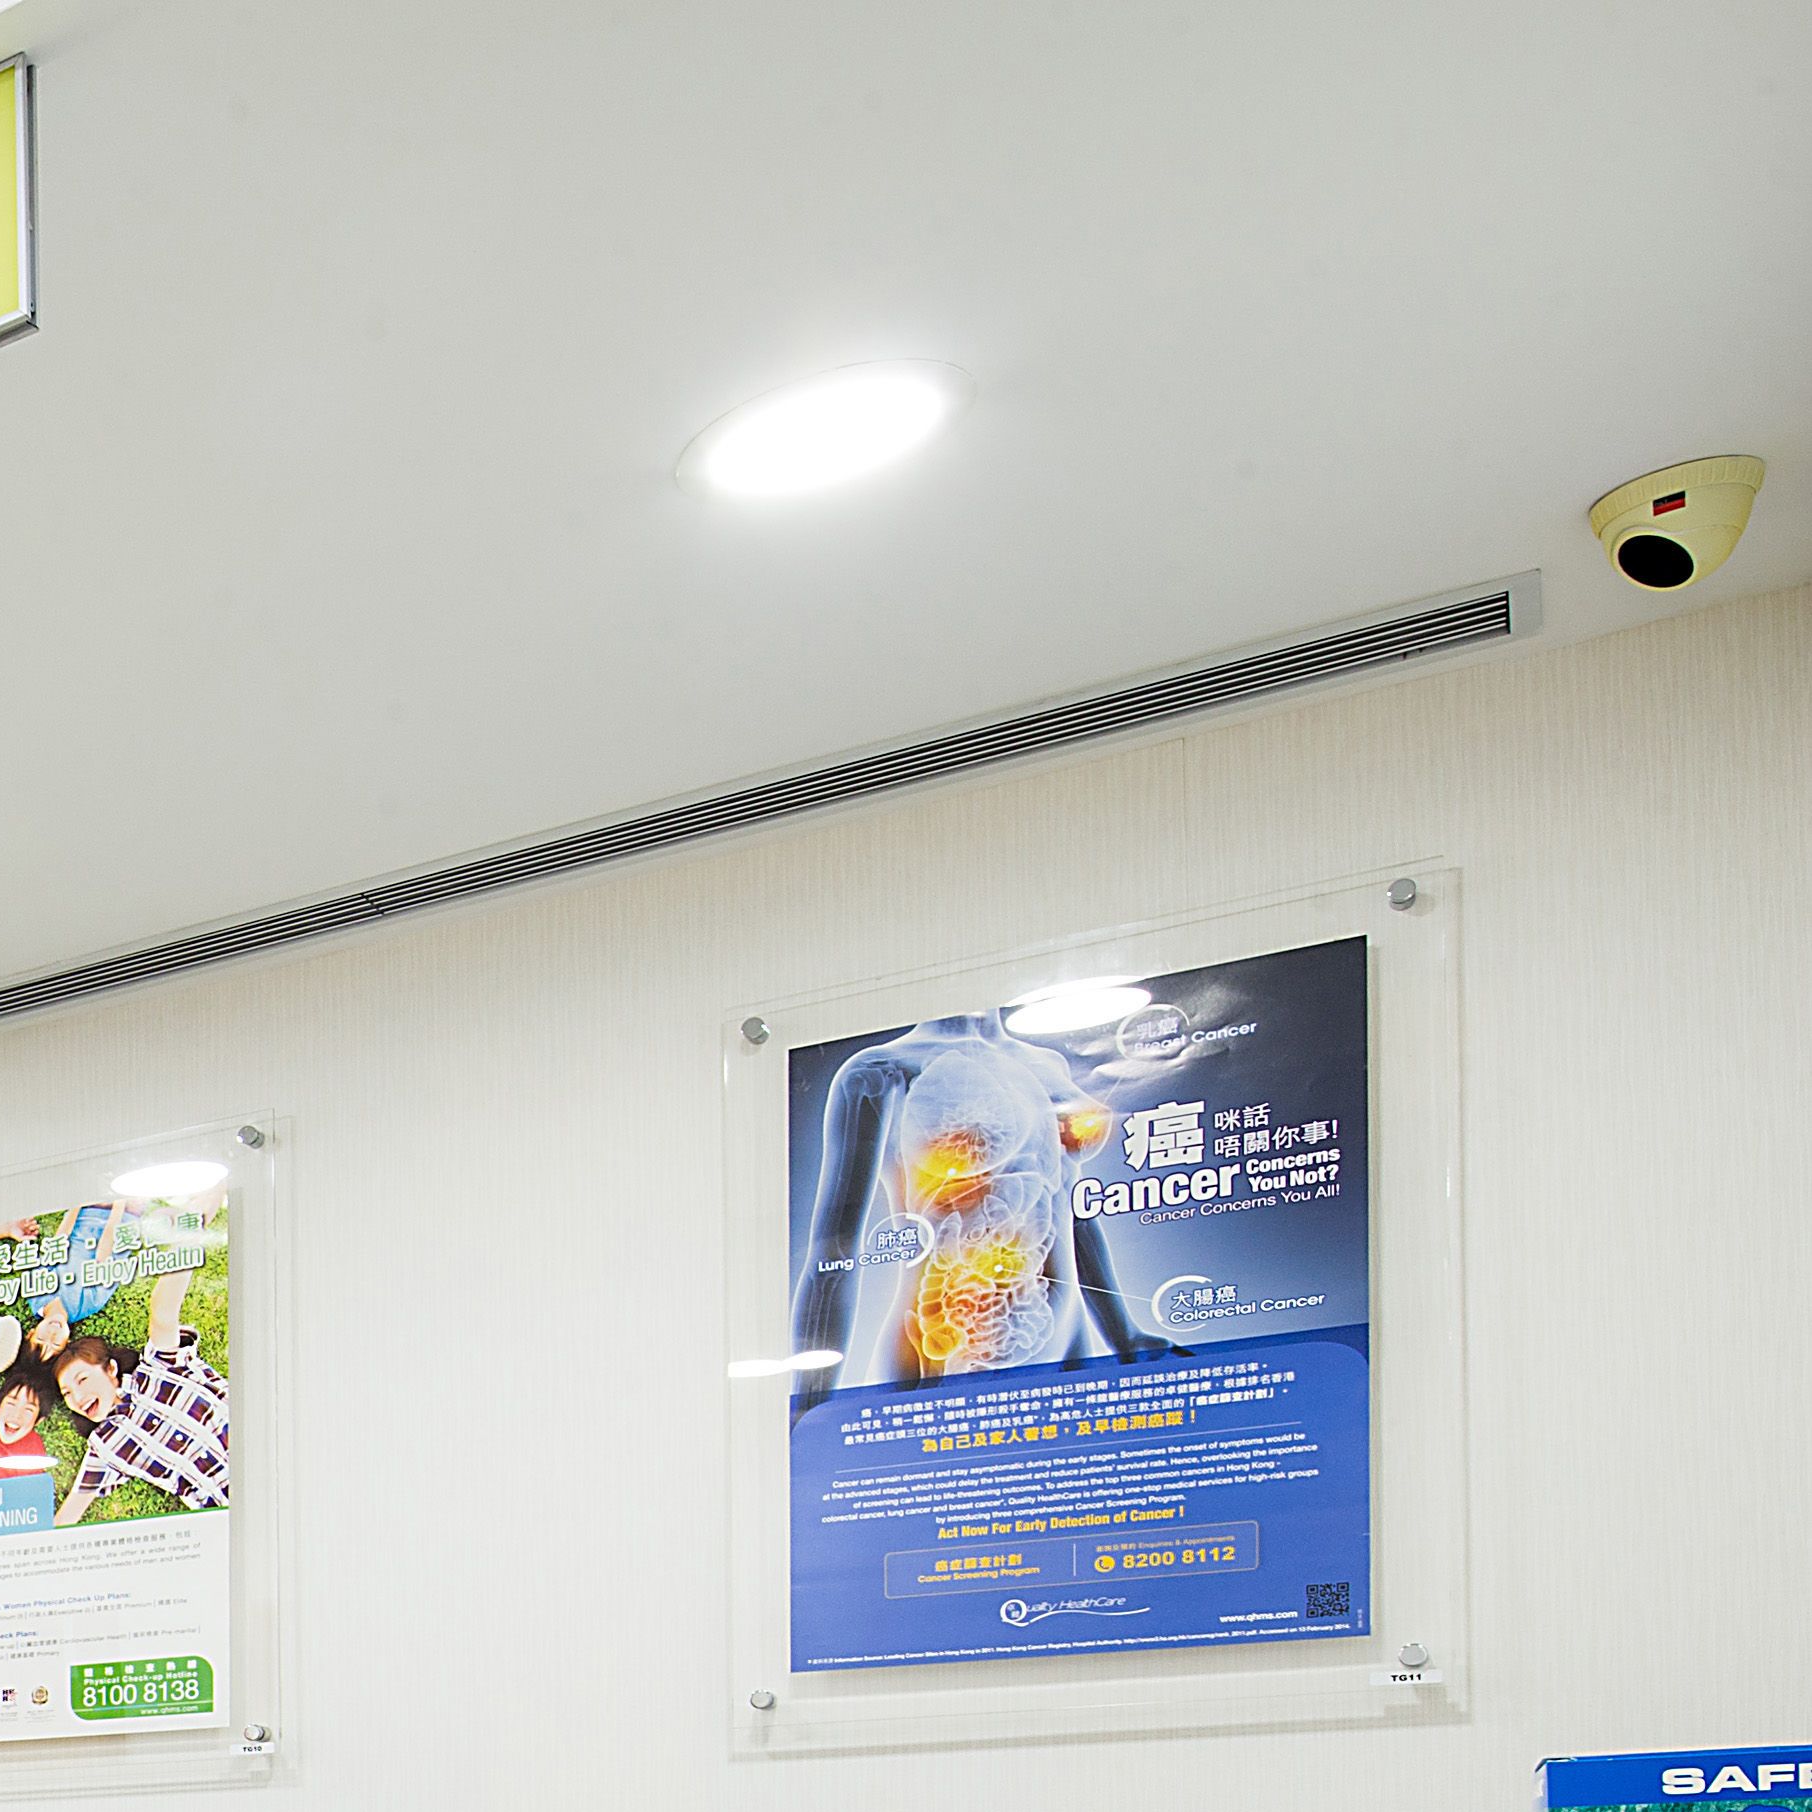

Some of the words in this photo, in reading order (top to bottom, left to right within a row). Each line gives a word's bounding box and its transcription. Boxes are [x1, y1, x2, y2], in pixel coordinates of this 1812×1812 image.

[1191, 1022, 1257, 1043] Cancer
[1214, 1102, 1272, 1132] 咪話
[1123, 1101, 1205, 1171] 癌
[1246, 1148, 1341, 1174] Concerns
[1072, 1162, 1242, 1220] Cancer
[1248, 1172, 1288, 1193] You
[1290, 1164, 1339, 1187] Not?
[1139, 1206, 1196, 1225] Cancer
[1200, 1195, 1276, 1216] Concerns
[1281, 1190, 1311, 1203] You
[1315, 1184, 1340, 1199] All!
[114, 1211, 203, 1251] 愛康
[876, 1227, 919, 1250] 肺癌
[21, 1270, 59, 1298] Life
[82, 1256, 140, 1287] Enjoy
[140, 1247, 204, 1276] Health
[817, 1256, 855, 1273] Lung
[858, 1247, 917, 1266] Cancer
[1169, 1299, 1257, 1324] Colorectal
[1260, 1292, 1327, 1313] Cancer
[1172, 1283, 1238, 1310] 大腸癌
[833, 1477, 859, 1488] Cancer
[859, 1477, 874, 1485] can
[874, 1473, 902, 1483] remain
[902, 1469, 934, 1480] dormant
[935, 1468, 950, 1477] and
[951, 1466, 968, 1477] stay
[969, 1460, 1024, 1476] asymptomatic
[1026, 1457, 1051, 1470] during
[1053, 1456, 1066, 1465] the
[1067, 1454, 1087, 1465] early
[1089, 1451, 1117, 1463] stages.
[1120, 1446, 1166, 1458] Sometimes
[1168, 1444, 1181, 1453] the
[1183, 1442, 1206, 1452] onset
[1208, 1440, 1217, 1449] of
[1219, 1436, 1263, 1450] symptoms
[1265, 1433, 1292, 1443] would
[1293, 1431, 1305, 1440] be
[936, 1514, 946, 1524] by
[946, 1511, 990, 1523] introducing
[991, 1509, 1012, 1518] three
[1013, 1503, 1073, 1518] comprehensive
[1075, 1501, 1104, 1511] Cancer
[1106, 1497, 1146, 1510] Screening
[1148, 1494, 1185, 1506] Program.
[938, 1526, 958, 1538] Act
[960, 1523, 988, 1536] Now
[991, 1521, 1012, 1534] For
[1015, 1518, 1046, 1534] Early
[1050, 1513, 1109, 1529] Detection
[1113, 1511, 1126, 1523] of
[1130, 1507, 1174, 1522] Cancer
[1123, 1552, 1175, 1569] 8200
[1181, 1546, 1236, 1564] 8112
[918, 1574, 951, 1583] Cancer
[953, 1570, 998, 1580] Screening
[1000, 1567, 1040, 1577] Program
[999, 1598, 1057, 1627] Quality
[1058, 1594, 1127, 1611] HealthCare
[1219, 1609, 1299, 1623] www.qhms.com
[1390, 1673, 1422, 1683] TG11
[83, 1684, 137, 1707] 8100
[143, 1679, 199, 1703] 8138
